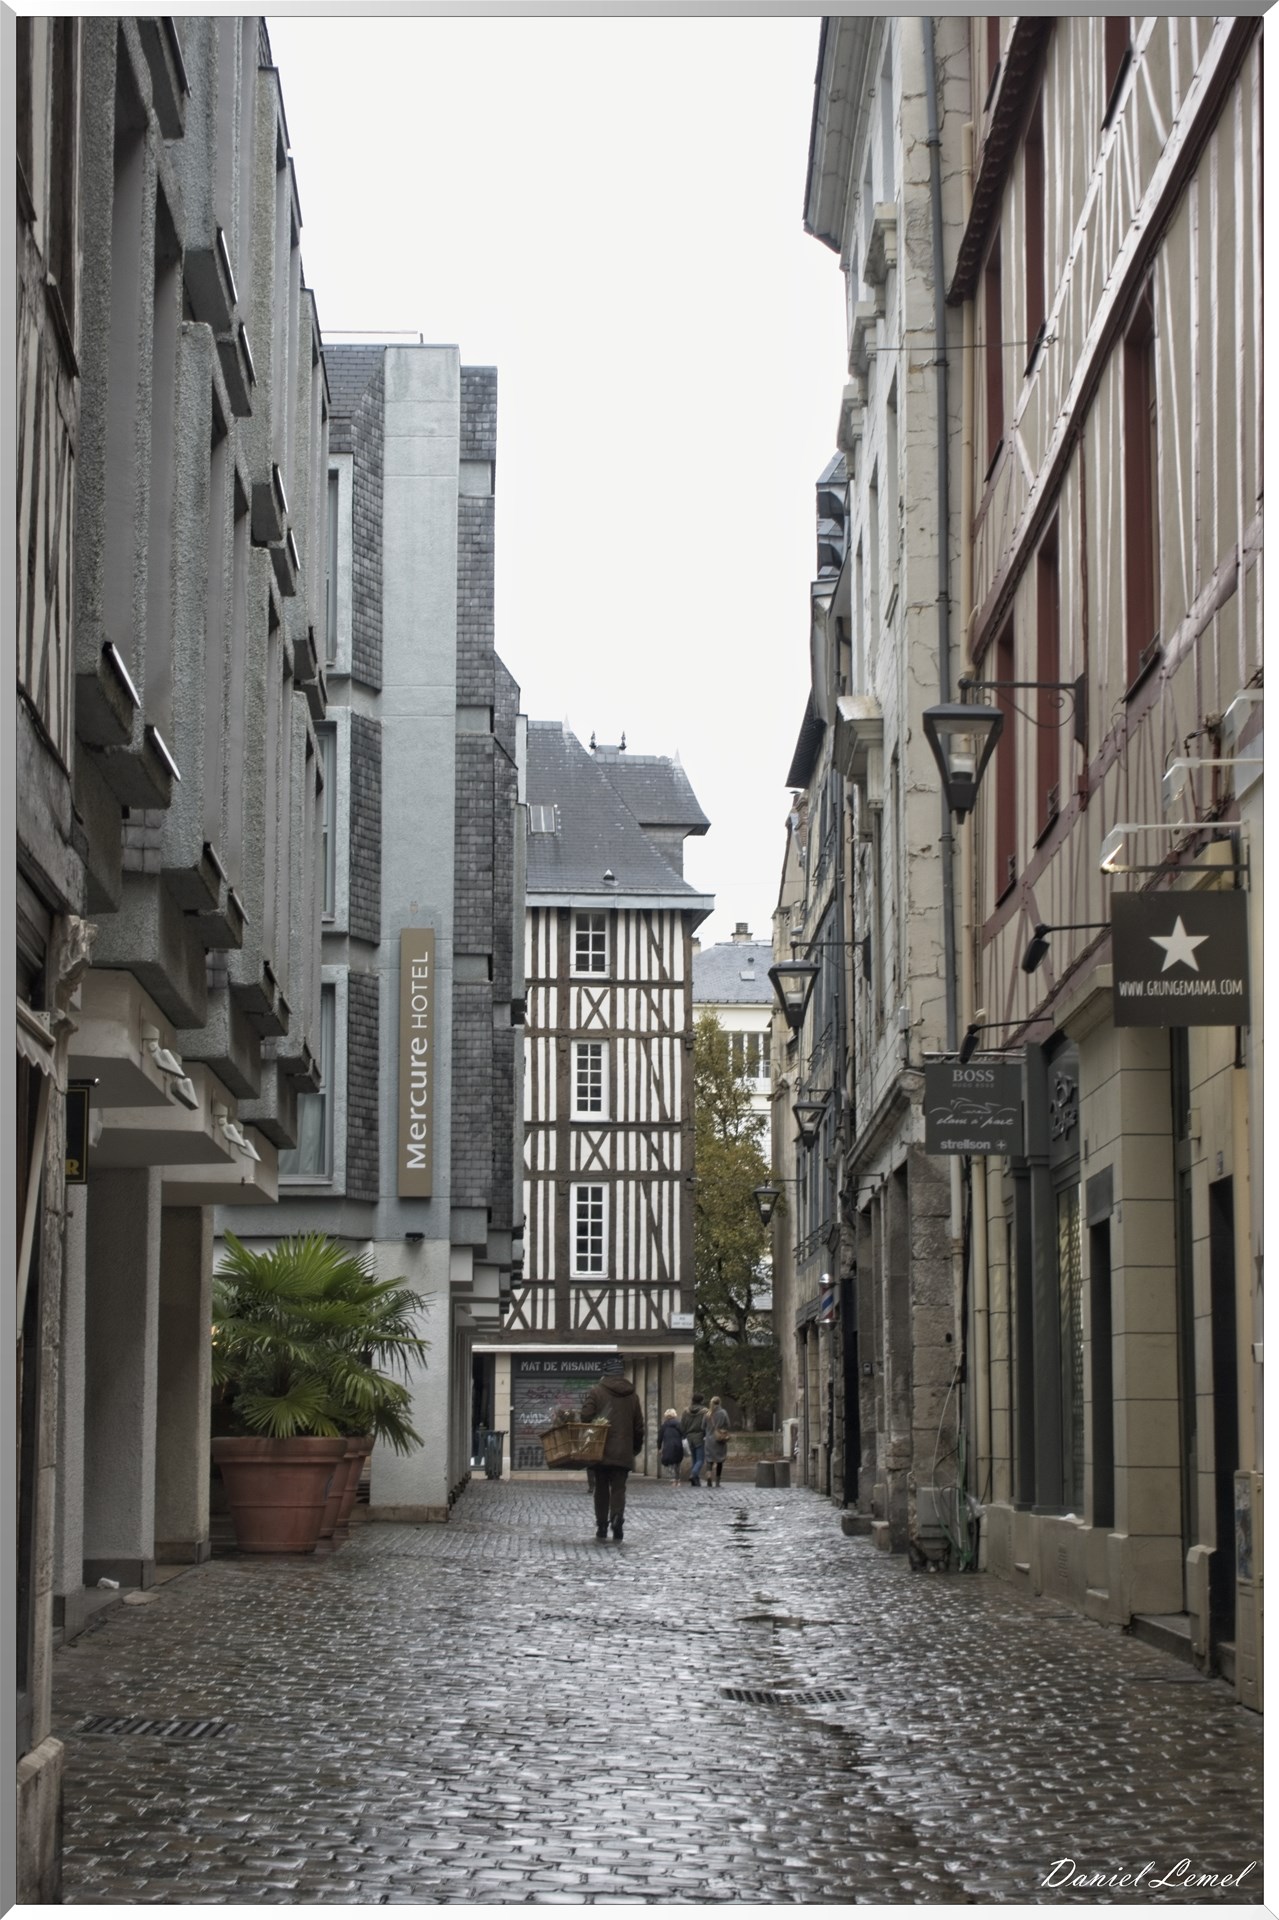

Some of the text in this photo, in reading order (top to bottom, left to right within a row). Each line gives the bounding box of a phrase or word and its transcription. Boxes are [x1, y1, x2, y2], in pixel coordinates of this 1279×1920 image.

[1118, 979, 1243, 997] WWW.GRUNGEMAMA.COM
[407, 951, 428, 1169] Mercure HOTEL
[952, 1069, 994, 1082] BOSS
[940, 1138, 991, 1150] strellson
[520, 1361, 602, 1372] MAT DE MISAINE
